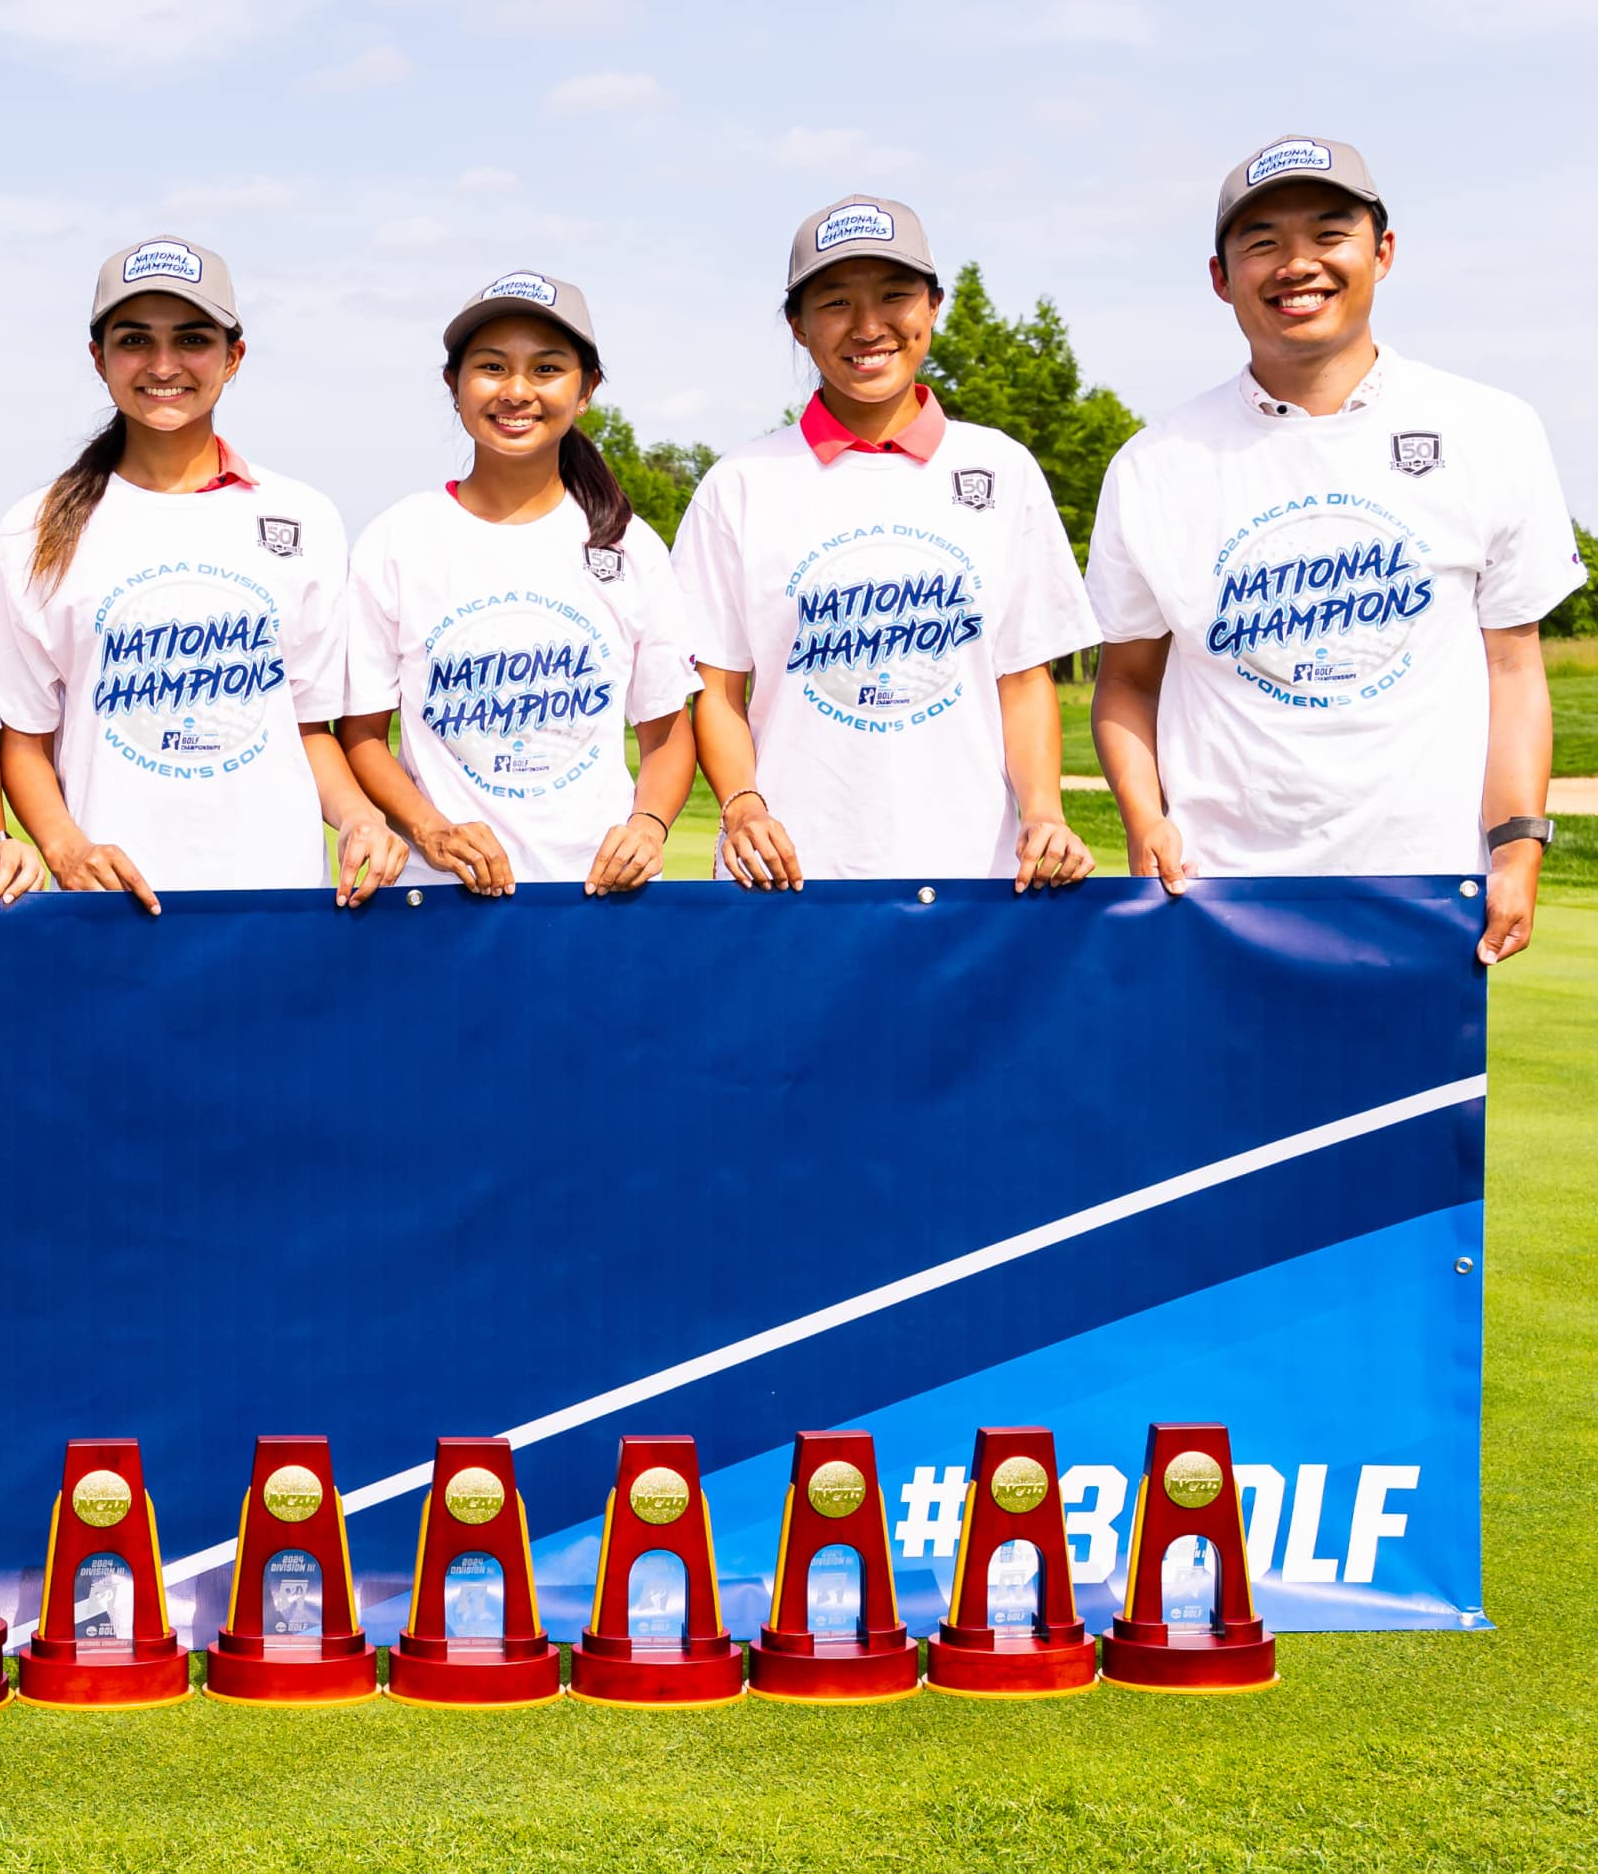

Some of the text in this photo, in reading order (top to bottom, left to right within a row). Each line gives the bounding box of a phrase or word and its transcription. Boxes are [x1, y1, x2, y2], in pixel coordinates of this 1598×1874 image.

[1252, 157, 1325, 179] CHAMPIONS
[1257, 150, 1315, 169] NATIONAL
[821, 226, 888, 244] CHAMPIONS
[826, 216, 880, 232] NATIONAL
[127, 263, 195, 276] CHAMPIONS
[134, 252, 187, 265] NATIONAL
[1402, 442, 1433, 460] 50
[962, 478, 987, 496] 50
[268, 525, 293, 545] 50
[592, 552, 616, 569] 50
[785, 523, 983, 599] 2024 NCAA DIVISION III
[1213, 493, 1432, 577] 2024 NCAA DIVISION III
[94, 586, 125, 635] 2024
[126, 561, 191, 588] NCAA
[197, 563, 278, 614] DIVISION
[800, 575, 969, 625] NATIONAL
[1219, 540, 1414, 615] NATIONAL
[424, 591, 611, 660] 024 NCAA DIVISION III
[786, 613, 984, 672] CHAMPIONS
[1207, 579, 1434, 653] CHAMPIONS
[103, 614, 273, 672] NATIONAL
[94, 656, 286, 715] CHAMPIONS
[427, 644, 597, 701] NATIONAL
[1237, 652, 1413, 709] WOMEN'S GOLF
[803, 683, 964, 734] WOMEN'S GOLF
[104, 727, 270, 780] WOMEN'S GOLF
[457, 745, 602, 800] OMEN'S GOLF
